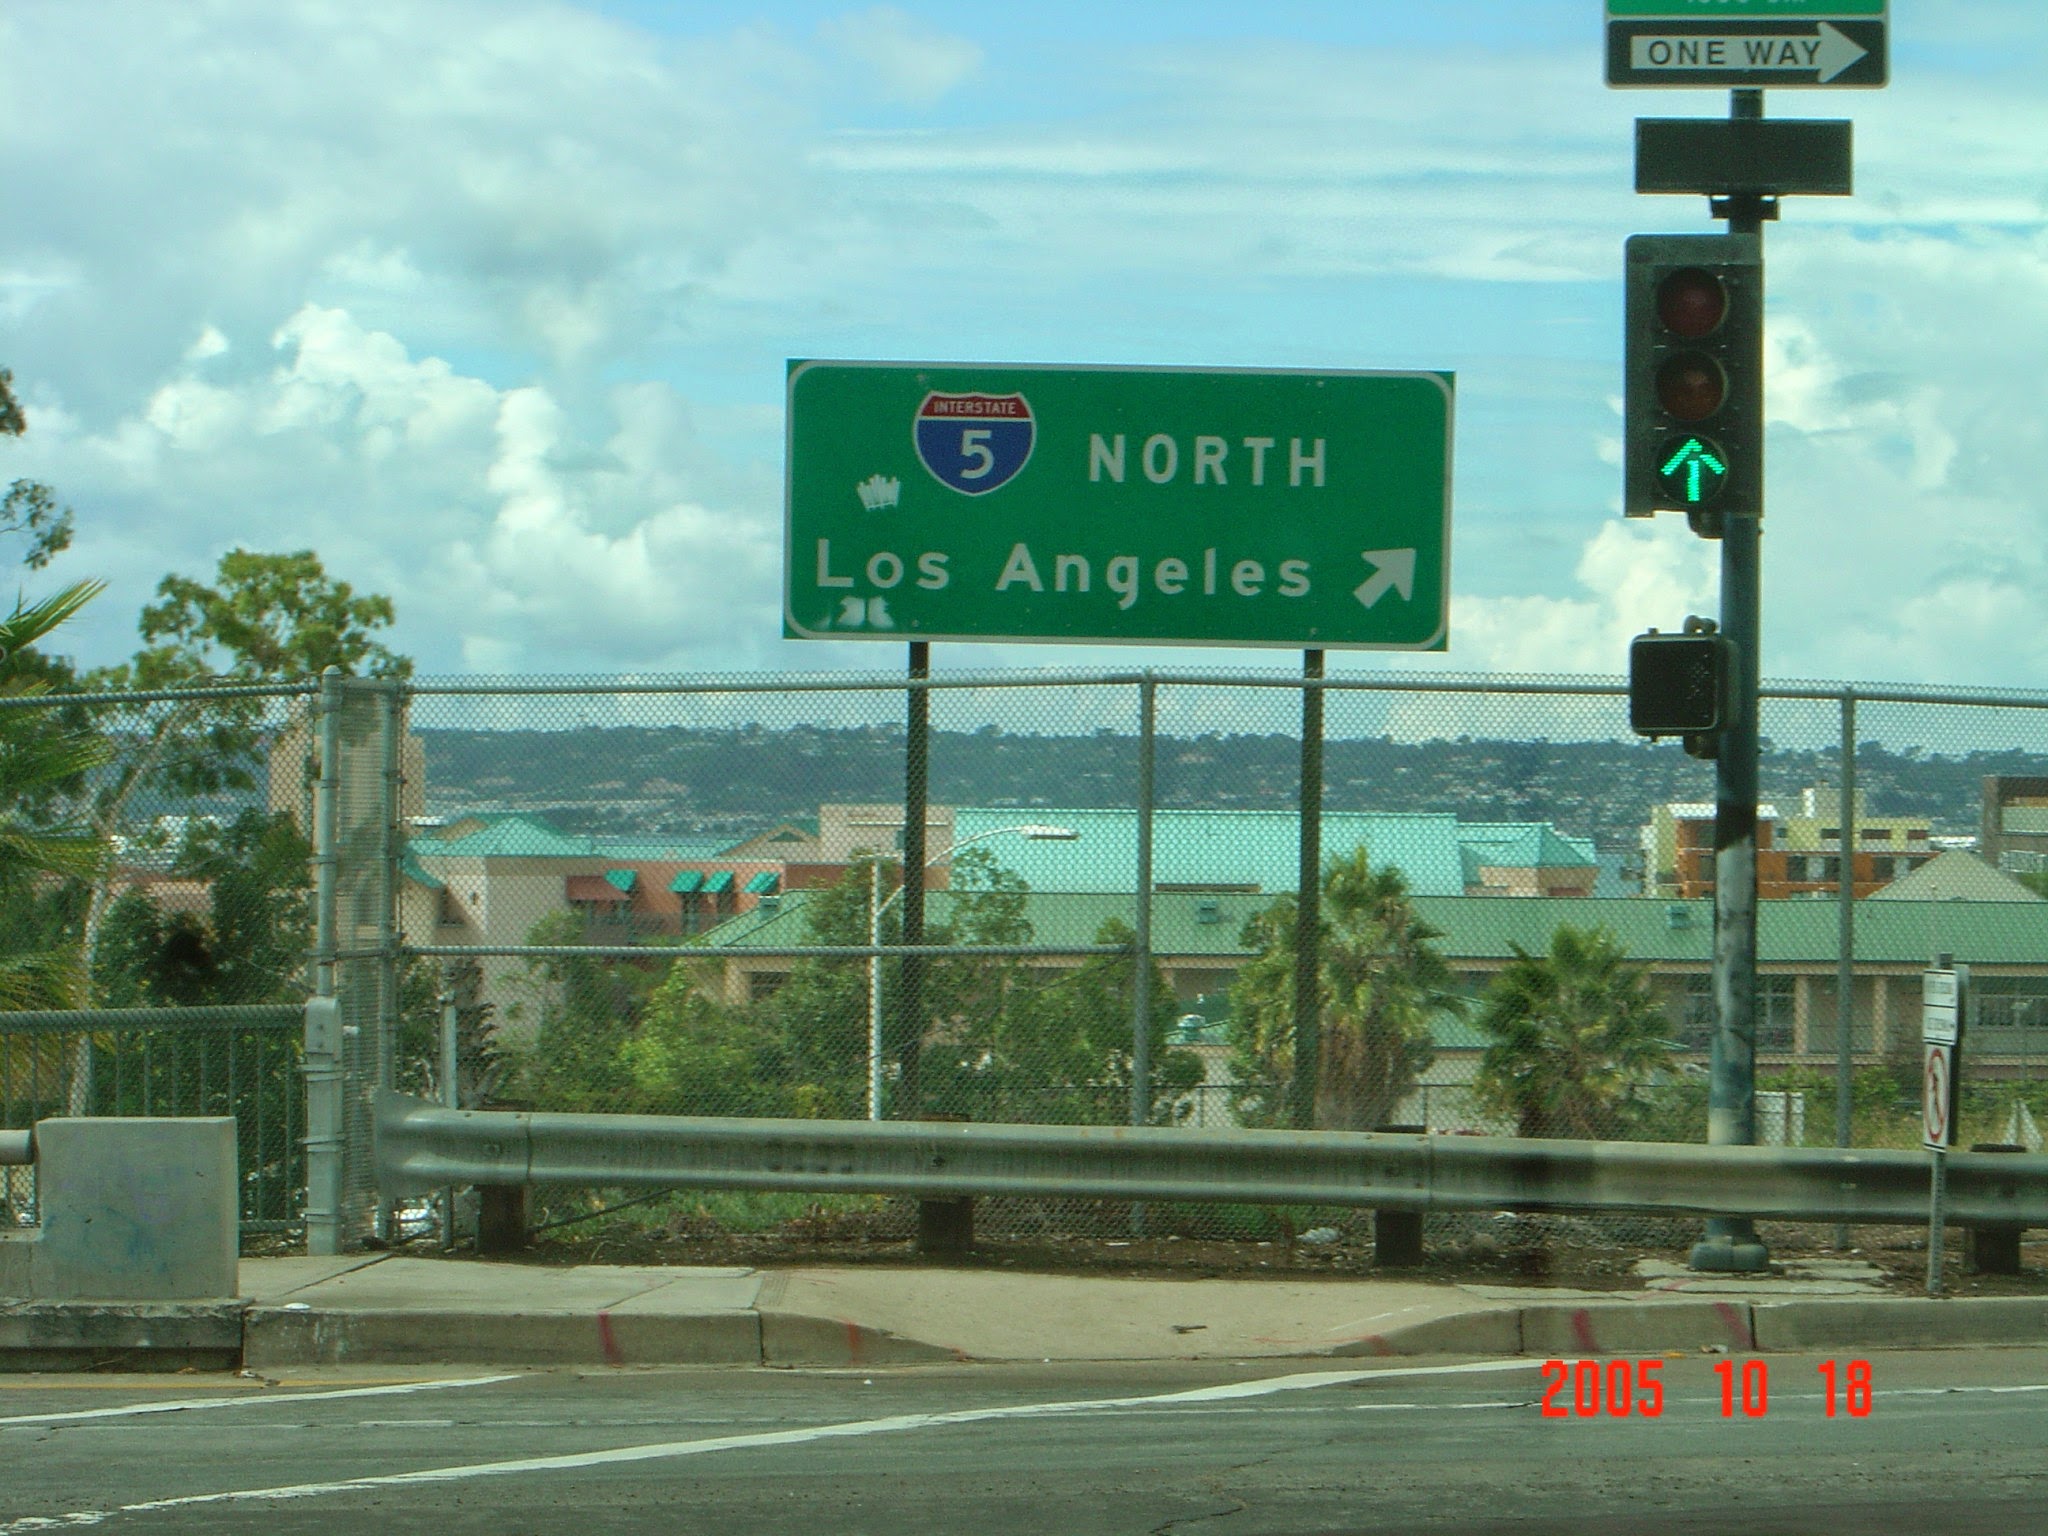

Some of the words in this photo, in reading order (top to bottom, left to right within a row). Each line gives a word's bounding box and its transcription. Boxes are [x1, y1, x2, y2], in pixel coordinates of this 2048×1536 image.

[1648, 40, 1726, 66] ONE
[1744, 40, 1822, 66] WAY
[933, 400, 1017, 415] INTERSTATE
[960, 429, 995, 479] 5
[1088, 433, 1326, 487] NORTH
[816, 538, 950, 590] Los
[995, 544, 1311, 611] Angeles
